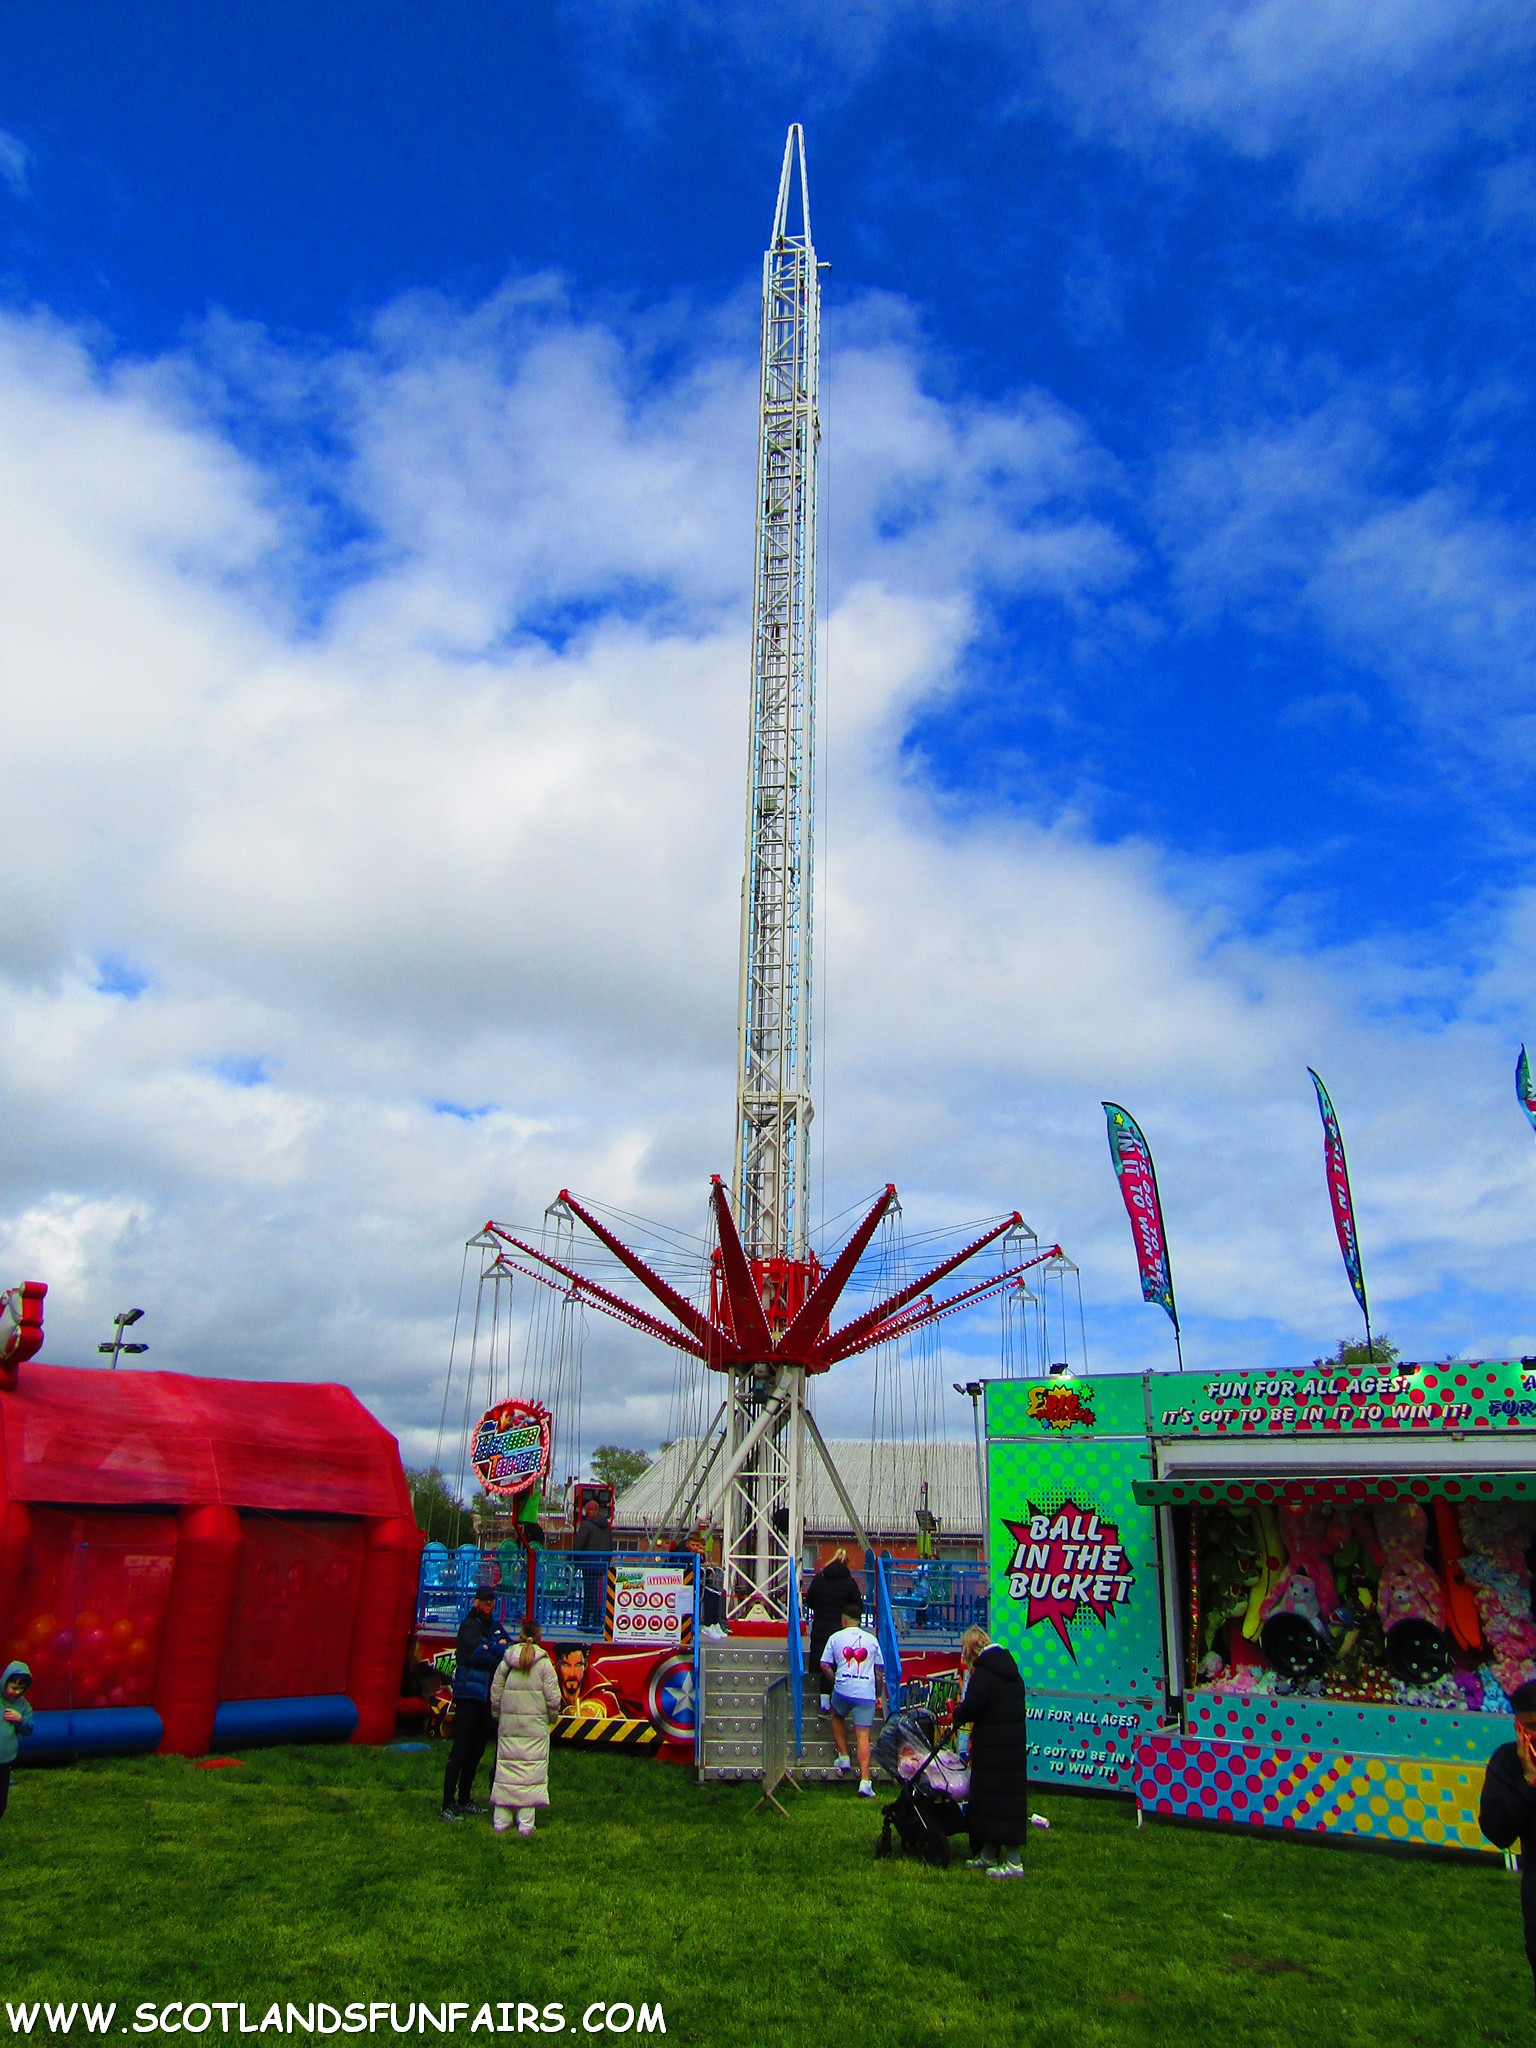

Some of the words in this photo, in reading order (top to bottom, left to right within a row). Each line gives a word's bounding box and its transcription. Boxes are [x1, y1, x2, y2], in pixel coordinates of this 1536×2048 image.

[1116, 1130, 1136, 1153] IN
[1134, 1138, 1149, 1174] IT'S
[1122, 1159, 1141, 1178] IT
[1130, 1185, 1146, 1209] TO
[1142, 1179, 1156, 1220] GOT
[1335, 1183, 1347, 1211] IN
[1138, 1216, 1154, 1259] WIN
[1149, 1226, 1160, 1251] TO
[1154, 1257, 1166, 1284] BE
[1208, 1382, 1249, 1398] FUN
[1255, 1380, 1296, 1397] FOR
[1302, 1379, 1340, 1395] ALL
[1347, 1376, 1410, 1395] AGES!
[1162, 1406, 1193, 1424] IT'S
[1198, 1409, 1235, 1423] GOT
[1240, 1408, 1263, 1423] TO
[1270, 1408, 1297, 1423] BE
[1302, 1407, 1325, 1422] IN
[1332, 1406, 1352, 1421] IT
[1359, 1405, 1383, 1421] TO
[1392, 1404, 1433, 1419] WIN
[1442, 1403, 1469, 1418] IT!
[1029, 1515, 1103, 1541] BALL
[1013, 1544, 1050, 1569] IN
[1062, 1545, 1123, 1571] THE
[647, 1576, 682, 1585] ATTENTION
[1008, 1572, 1134, 1603] BUCKET
[1026, 1707, 1044, 1719] UN
[1047, 1709, 1073, 1722] FOR
[1075, 1712, 1098, 1724] ALL
[1101, 1714, 1139, 1728] AGES!
[1026, 1742, 1040, 1755] T'S
[1043, 1746, 1067, 1758] GOT
[1071, 1748, 1086, 1760] TO
[1090, 1751, 1108, 1762] BE
[1111, 1752, 1127, 1764] IN
[1049, 1760, 1065, 1772] TO
[1069, 1763, 1095, 1775] WIN
[1099, 1765, 1115, 1777] IT!
